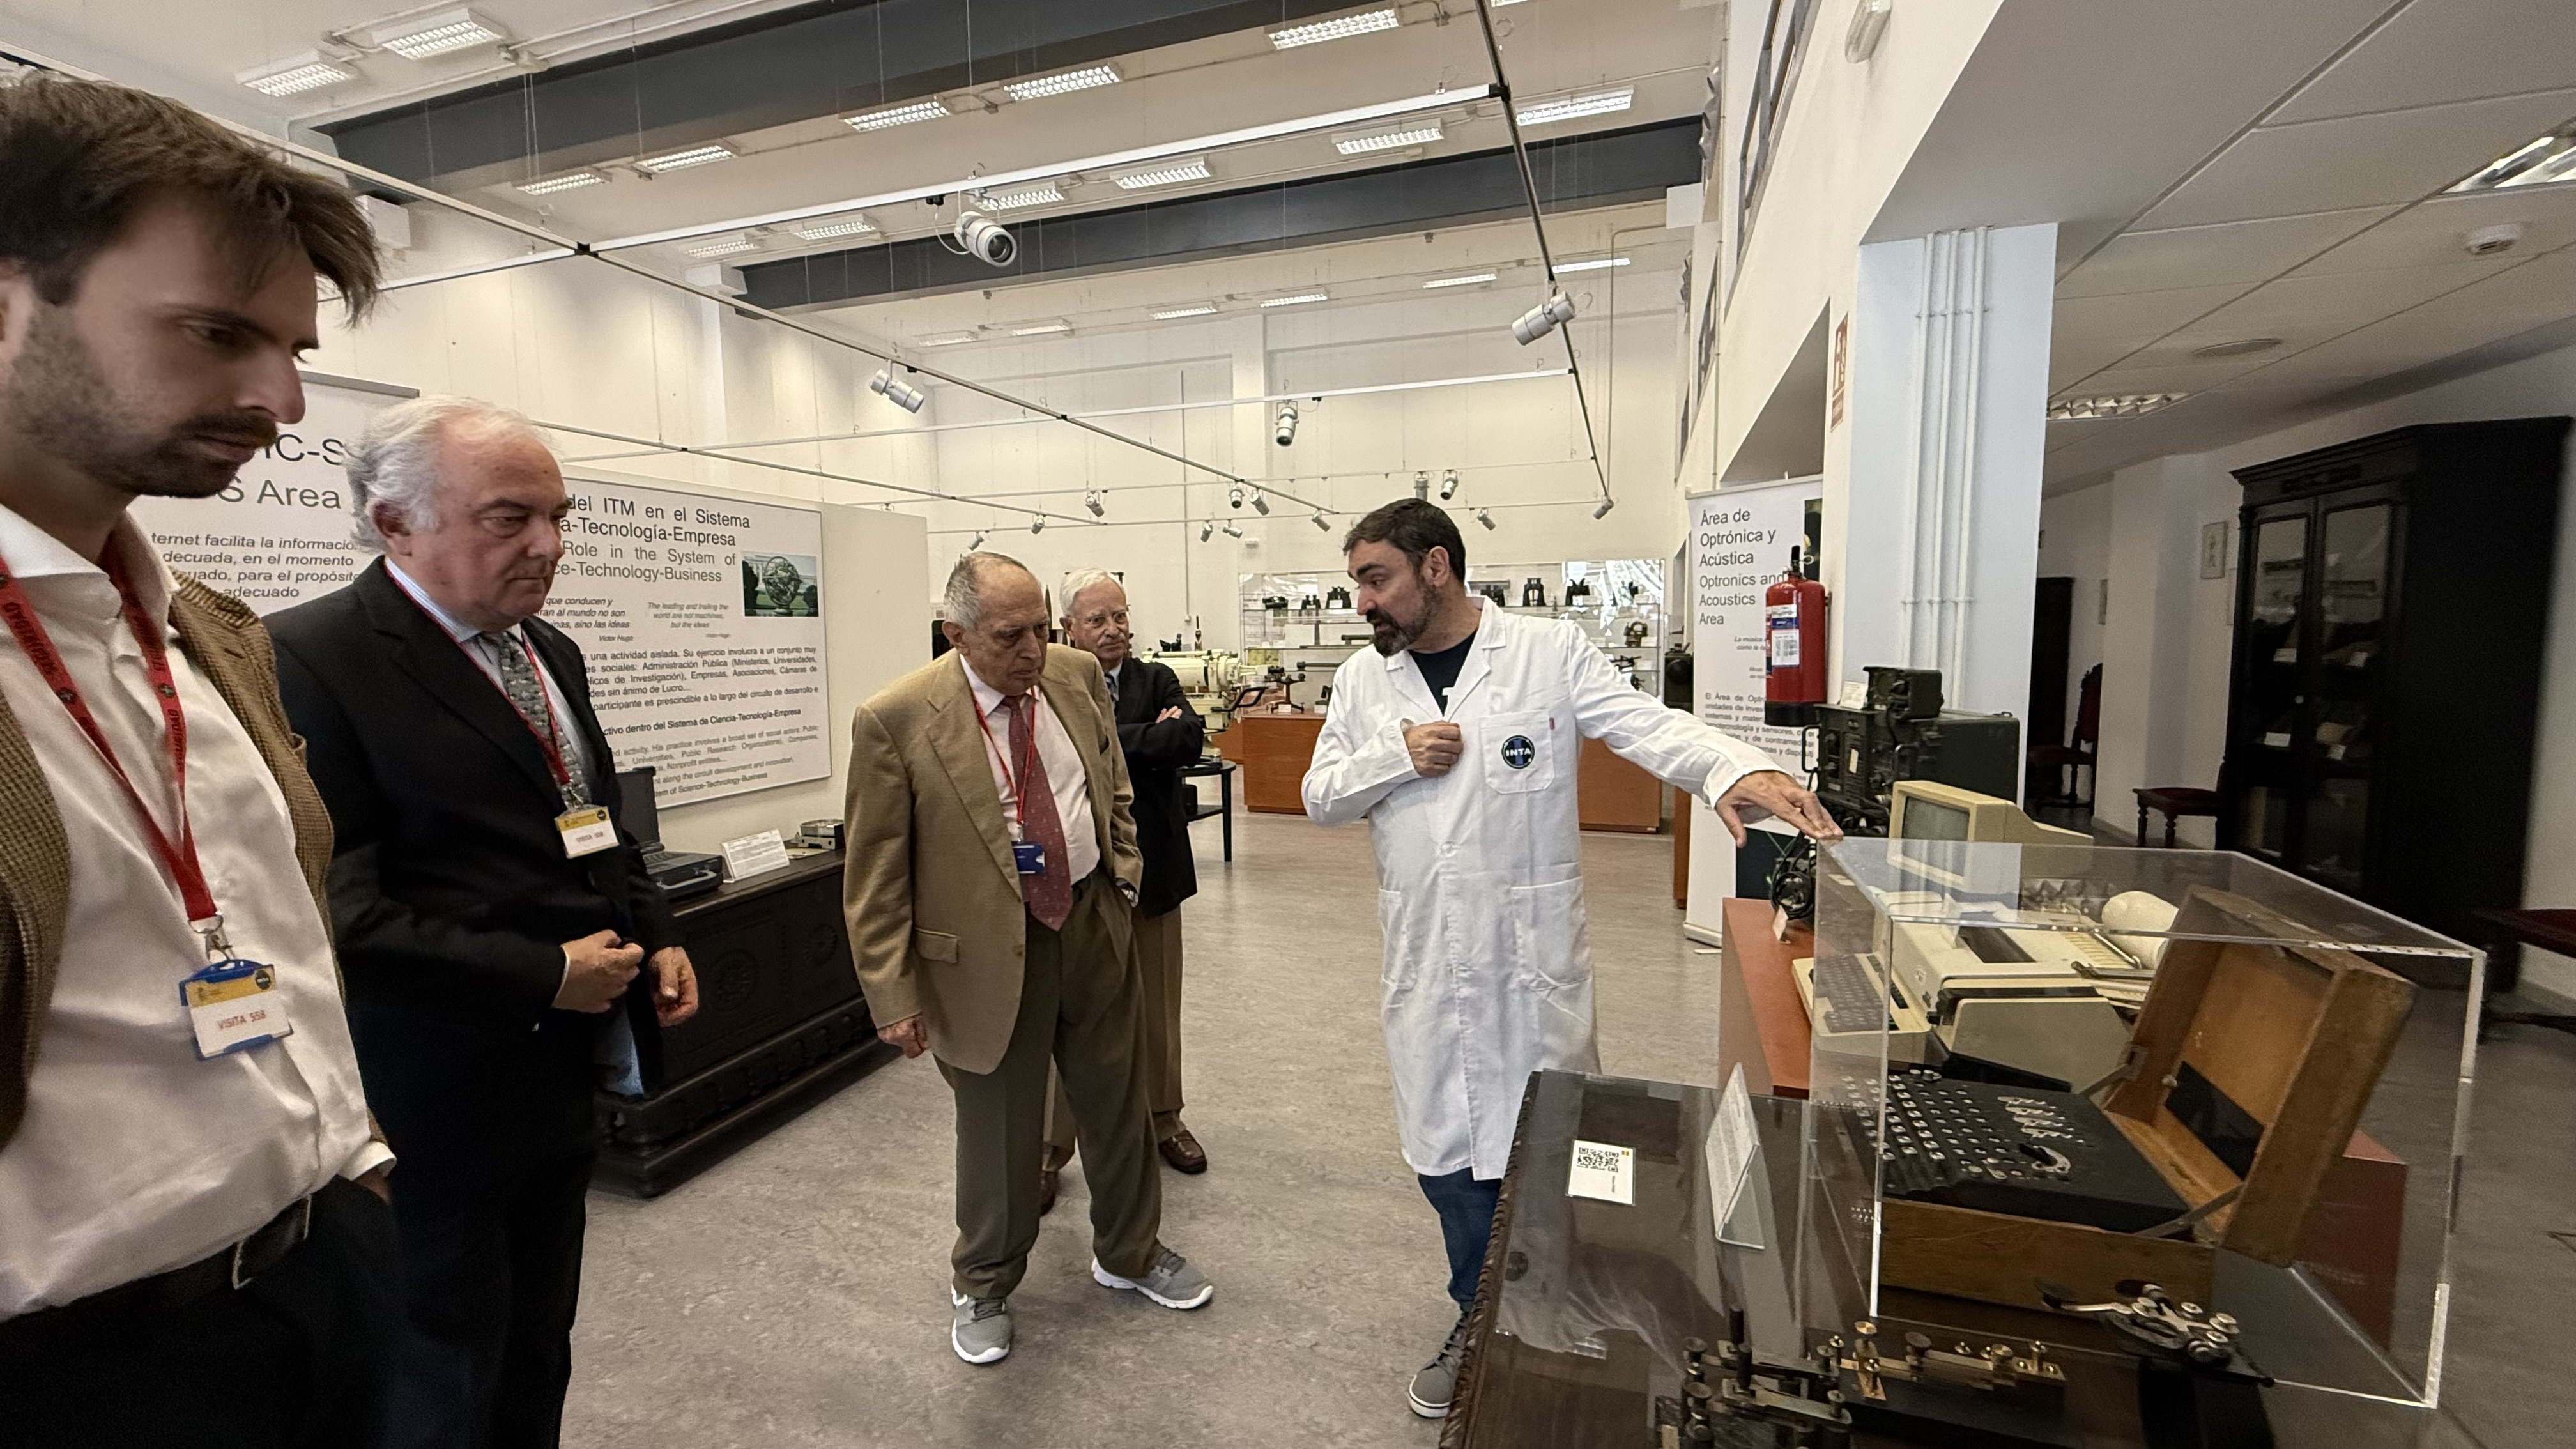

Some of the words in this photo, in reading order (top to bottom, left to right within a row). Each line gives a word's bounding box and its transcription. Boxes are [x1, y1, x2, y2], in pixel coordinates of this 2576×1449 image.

[257, 479, 341, 509] Area
[567, 494, 592, 511] del
[604, 497, 634, 516] ITM
[645, 506, 664, 519] en
[674, 507, 686, 521] el
[696, 508, 751, 528] Sistema
[1700, 509, 1728, 526] Área
[1733, 508, 1751, 523] de
[205, 534, 255, 548] facilita
[261, 537, 273, 548] la
[1699, 528, 1763, 549] Optrónica
[1768, 529, 1776, 544] y
[562, 540, 597, 556] Role
[610, 544, 623, 558] in
[634, 546, 656, 561] the
[668, 548, 715, 565] System
[724, 553, 736, 565] of
[1699, 550, 1754, 567] Acústica
[243, 554, 262, 564] en
[268, 553, 280, 564] el
[286, 556, 354, 566] momento
[238, 571, 272, 583] para
[277, 571, 291, 581] el
[1699, 573, 1756, 590] Optronics
[565, 597, 606, 605] conducen
[1699, 592, 1756, 606] Acoustics
[556, 608, 565, 617] al
[567, 608, 596, 617] mundo
[1699, 613, 1724, 625] Area
[574, 620, 592, 629] sino
[594, 620, 606, 628] las
[608, 620, 630, 628] ideas
[610, 650, 647, 659] actividad
[683, 648, 693, 657] Su
[588, 677, 610, 685] licos
[608, 688, 620, 696] sin
[622, 687, 647, 695] ánimo
[650, 685, 659, 693] de
[626, 724, 651, 733] dentro
[654, 721, 665, 730] del
[668, 718, 697, 728] Sistema
[700, 717, 709, 726] de
[1505, 747, 1531, 757] INTA
